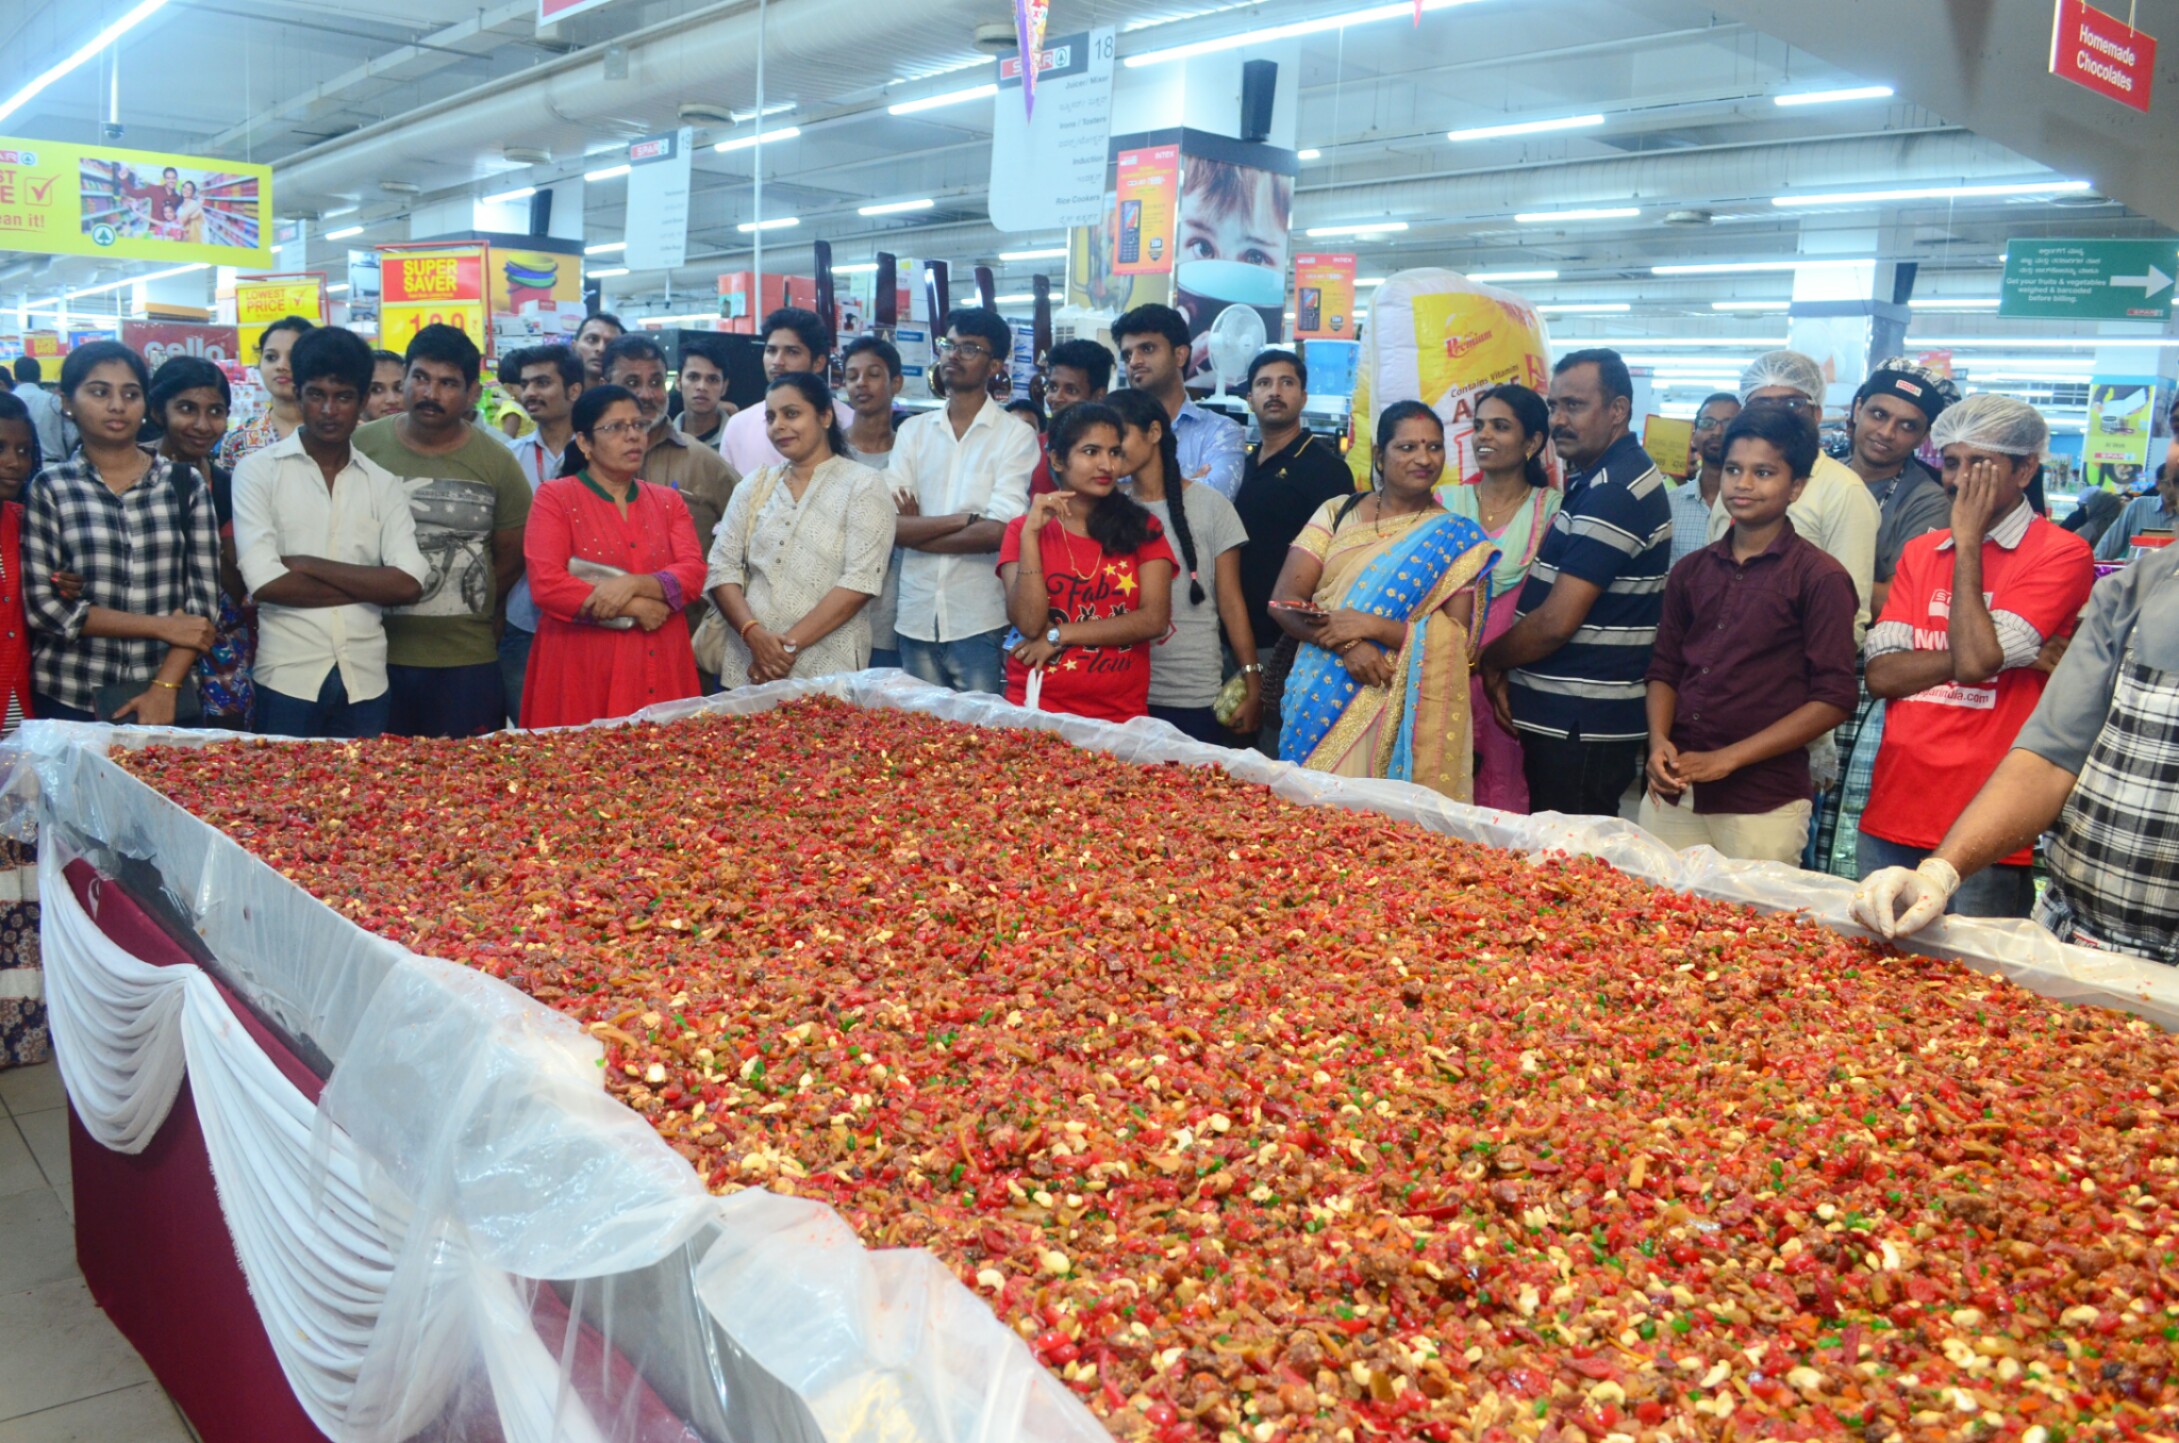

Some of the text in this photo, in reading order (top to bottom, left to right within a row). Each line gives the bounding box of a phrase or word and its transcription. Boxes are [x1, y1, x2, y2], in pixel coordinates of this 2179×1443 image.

[1096, 35, 1114, 60] 18
[2080, 23, 2135, 66] Homemade
[1012, 50, 1053, 74] SR
[2077, 49, 2133, 92] Chocolates
[635, 141, 659, 157] SPAR
[1056, 194, 1100, 205] Rice Cookers
[28, 213, 45, 228] it!
[403, 258, 459, 276] SUPER
[403, 274, 459, 293] SAVER
[2018, 286, 2048, 295] weighed
[2020, 279, 2036, 287] your
[2066, 279, 2107, 287] vegetables
[246, 288, 286, 301] LOWEST
[247, 299, 286, 314] PRICE
[1445, 329, 1493, 359] Premium
[1451, 376, 1489, 398] Contains
[1489, 364, 1520, 382] Vitamins
